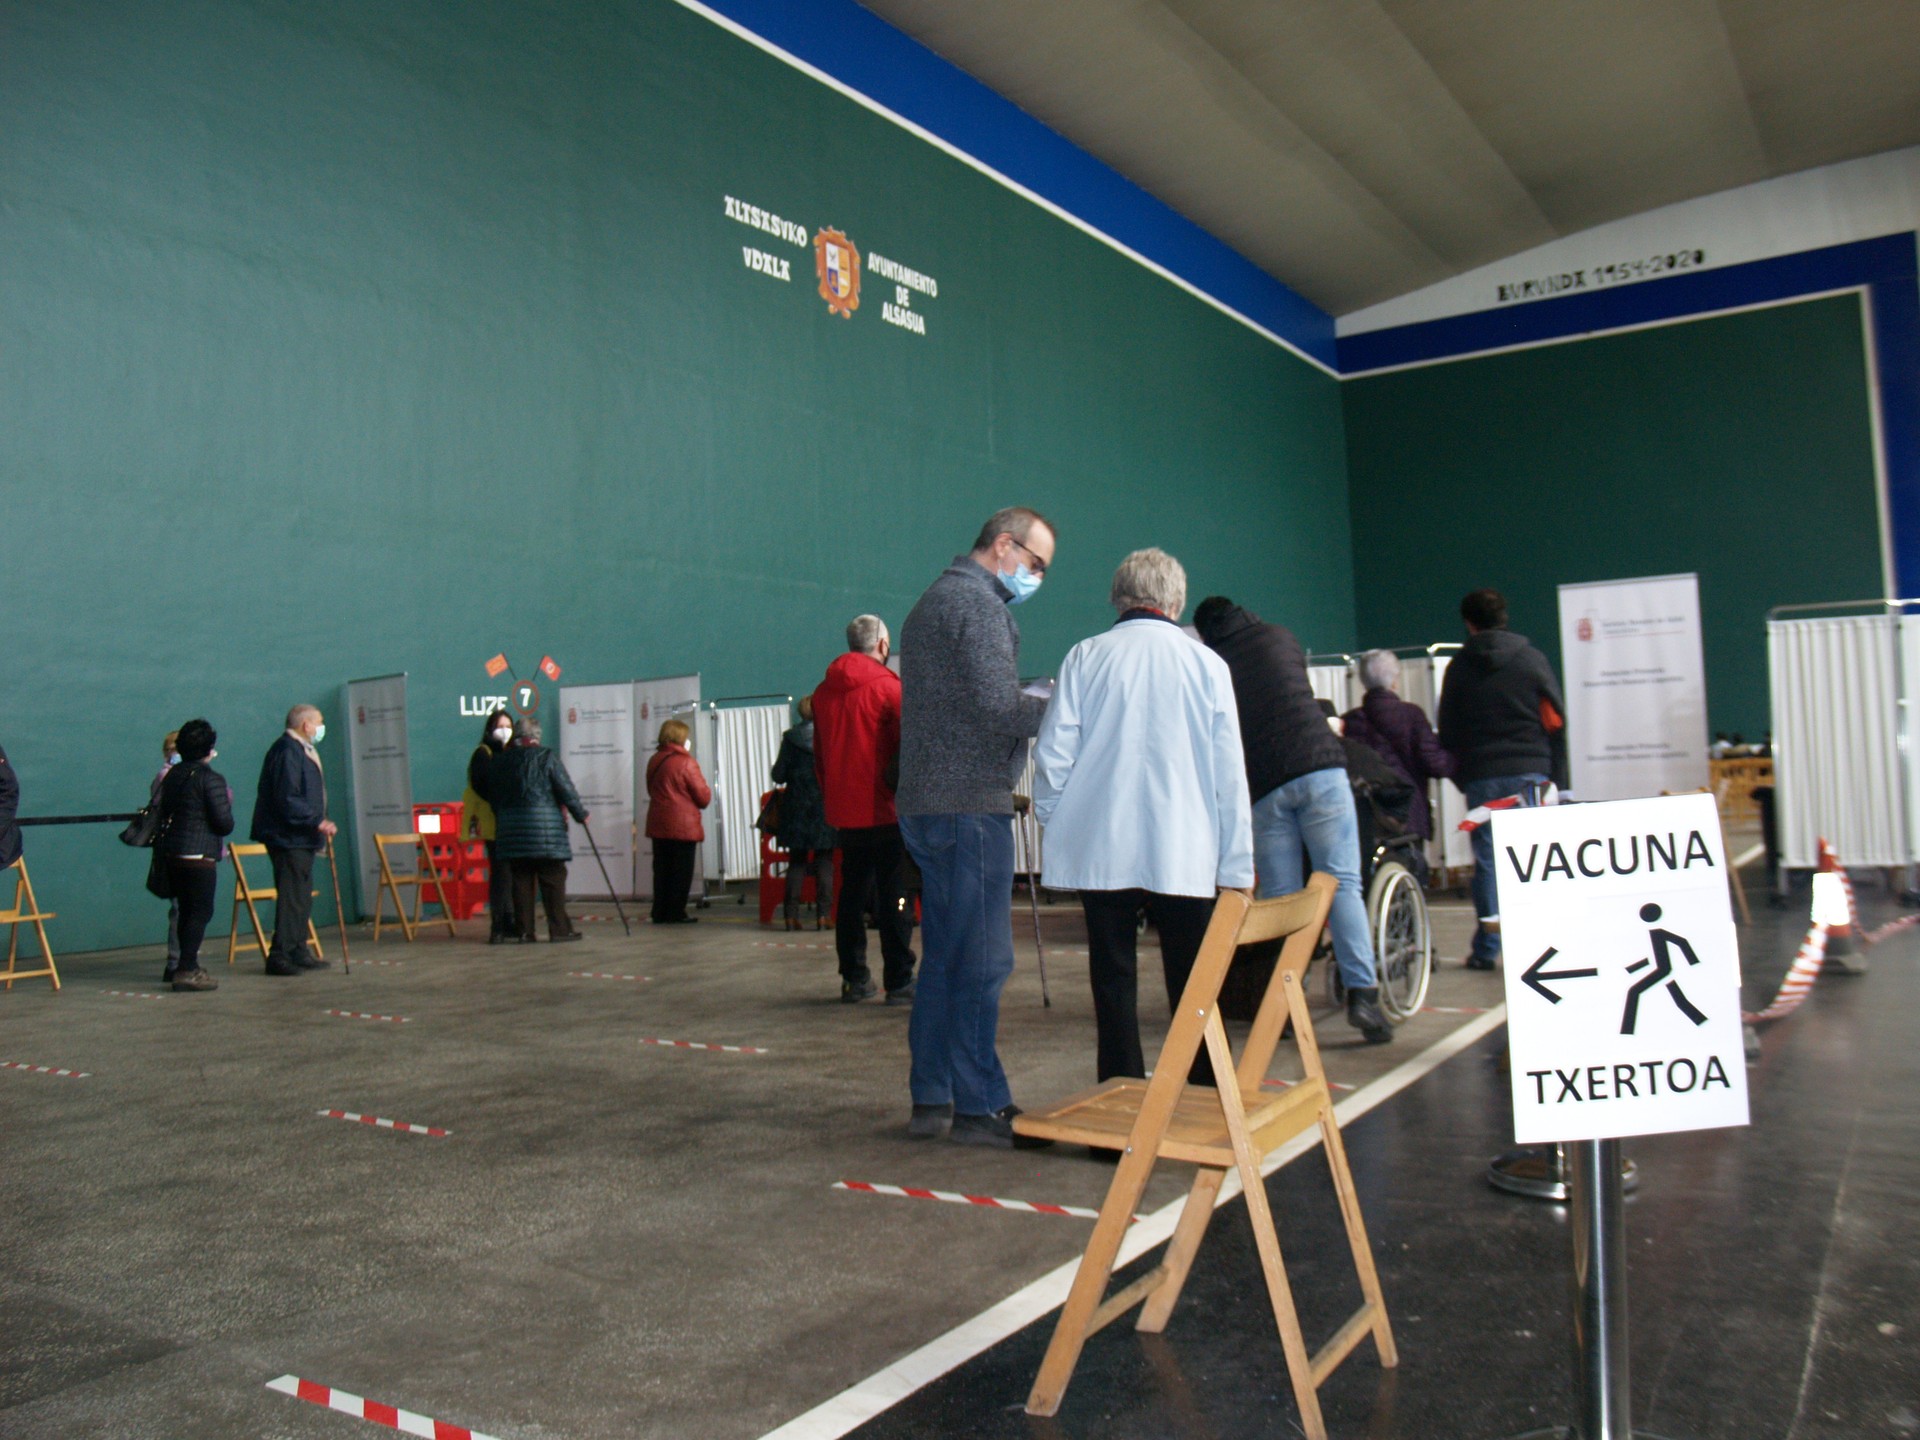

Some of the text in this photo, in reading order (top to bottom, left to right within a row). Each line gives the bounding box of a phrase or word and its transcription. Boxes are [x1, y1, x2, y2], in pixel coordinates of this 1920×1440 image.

[868, 251, 938, 298] AYUNTAMIENTO
[896, 285, 910, 307] DE
[882, 302, 926, 335] ALSASUA
[520, 688, 532, 708] 7
[1505, 829, 1715, 884] VACUNA
[1526, 1055, 1731, 1105] TXERTOA
